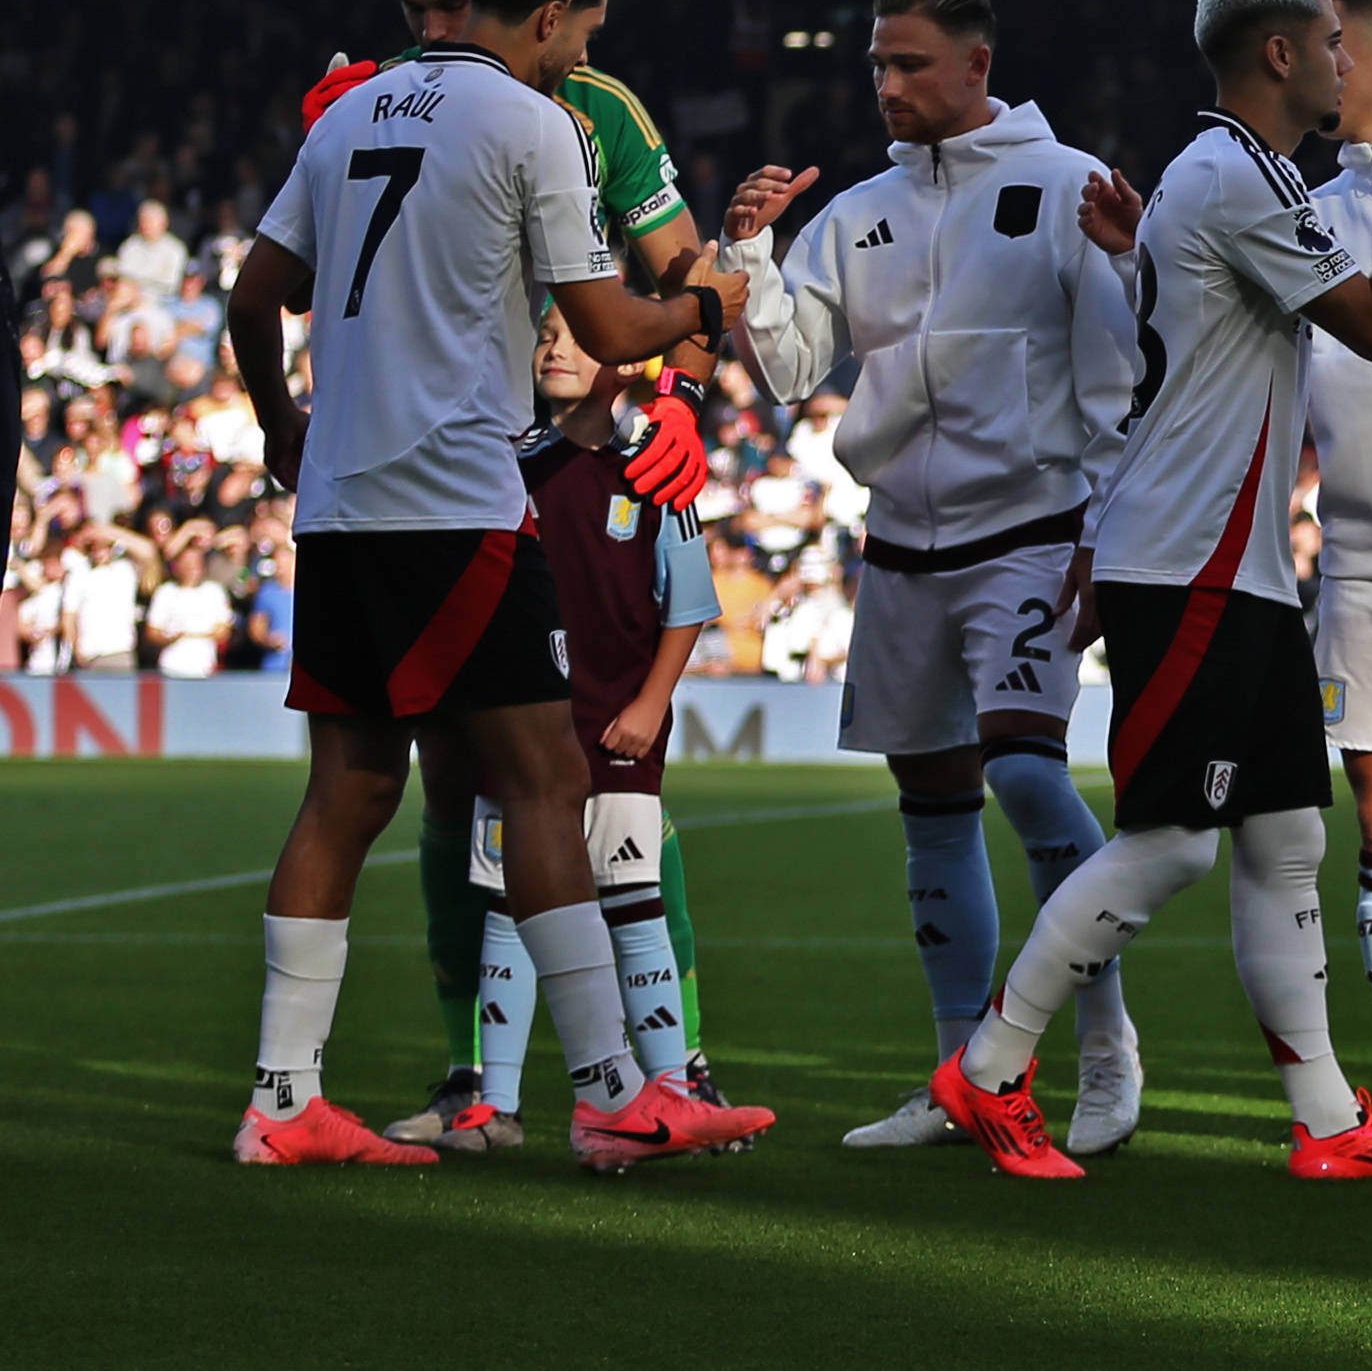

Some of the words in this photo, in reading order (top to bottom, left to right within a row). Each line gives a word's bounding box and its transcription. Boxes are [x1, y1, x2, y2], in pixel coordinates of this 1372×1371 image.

[373, 84, 445, 125] RAÚL
[342, 145, 425, 319] 7
[1010, 596, 1057, 663] 2
[1295, 908, 1320, 930] FF
[624, 968, 671, 990] 1874
